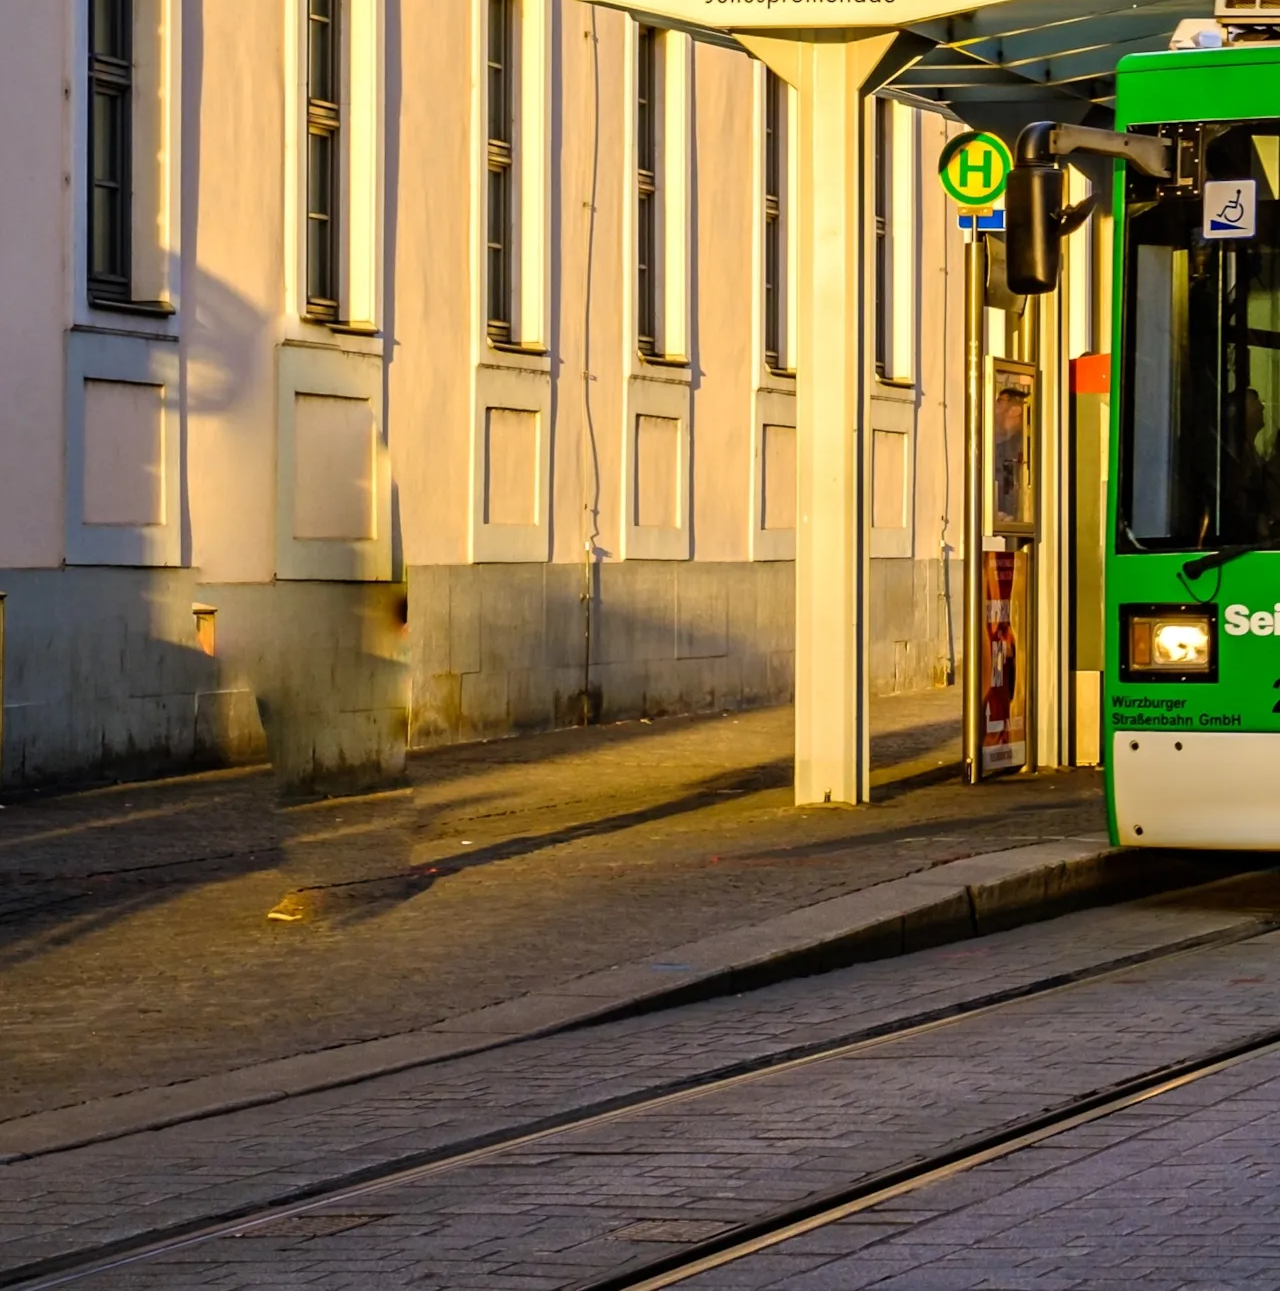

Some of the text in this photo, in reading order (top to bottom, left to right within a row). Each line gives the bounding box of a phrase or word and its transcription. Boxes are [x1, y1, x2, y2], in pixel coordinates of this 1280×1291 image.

[959, 150, 992, 188] H
[1112, 696, 1187, 710] Würzburger
[1112, 713, 1241, 726] Straßenbahn GmbH
